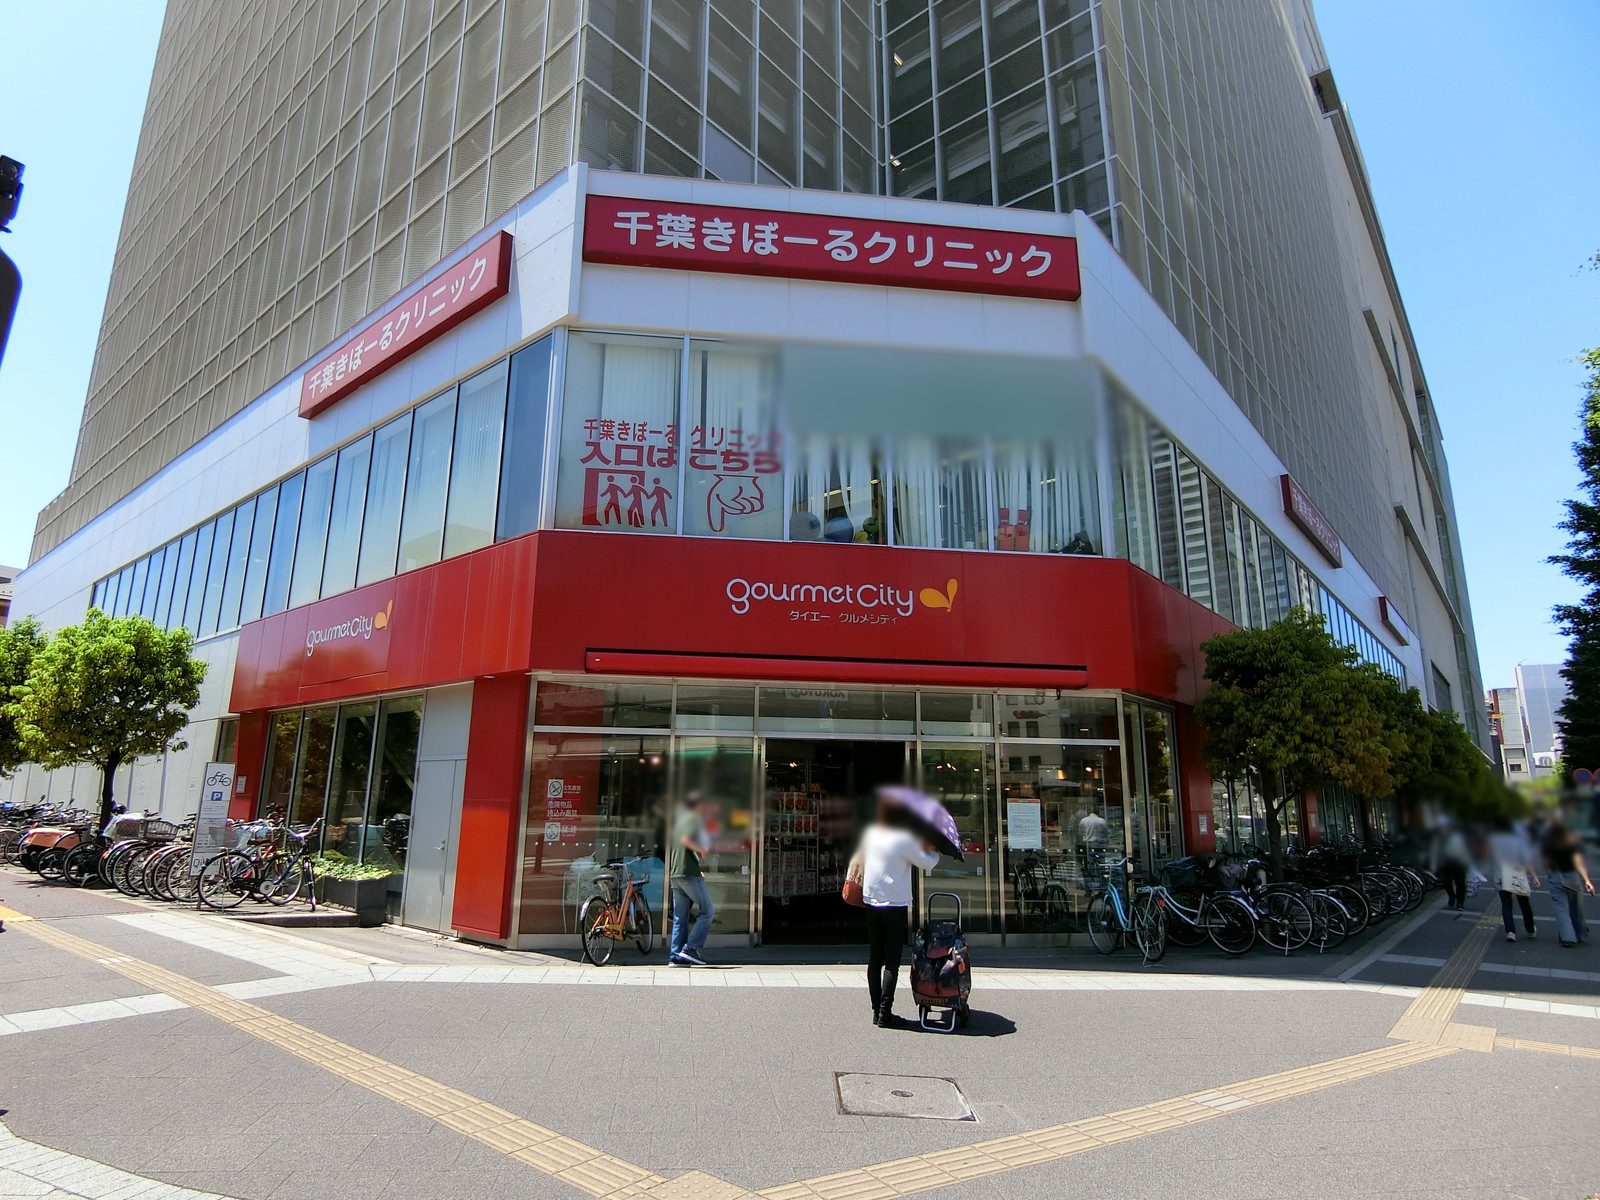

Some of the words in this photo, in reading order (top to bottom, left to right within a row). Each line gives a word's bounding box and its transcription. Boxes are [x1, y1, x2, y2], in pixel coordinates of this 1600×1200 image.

[613, 211, 1053, 277] 千葉きぼーるクリニック
[308, 256, 488, 399] 千葉きぼーるクリニック
[583, 418, 678, 445] 千葉きぼーる
[580, 441, 678, 468] 入口は
[688, 448, 783, 475] こちら
